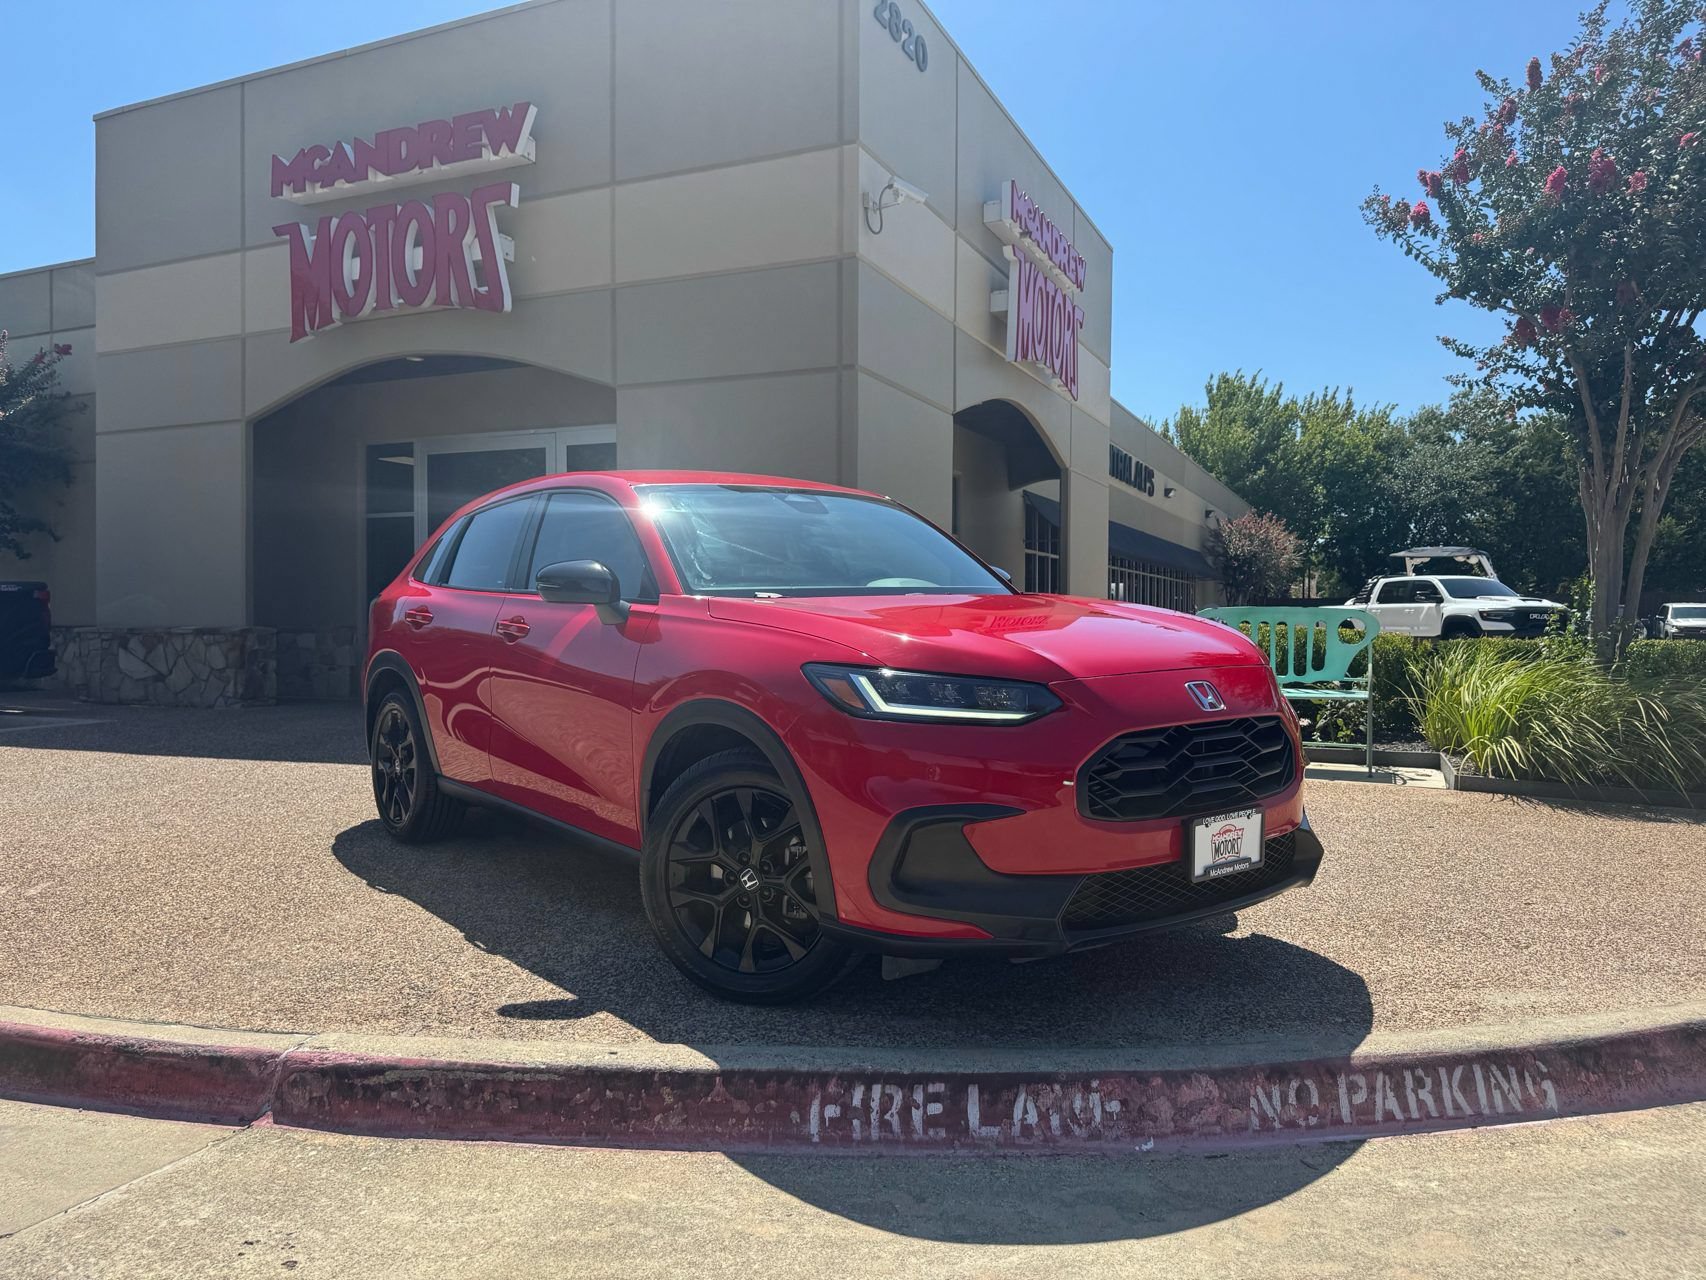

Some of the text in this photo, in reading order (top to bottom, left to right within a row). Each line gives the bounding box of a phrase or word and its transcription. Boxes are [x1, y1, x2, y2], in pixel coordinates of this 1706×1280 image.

[874, 0, 928, 72] 2820
[272, 181, 514, 343] MOTORS
[1011, 244, 1085, 401] MOTORS
[1212, 837, 1241, 861] MOTORS
[1249, 1076, 1319, 1131] NO
[1337, 1061, 1559, 1124] PARKING
